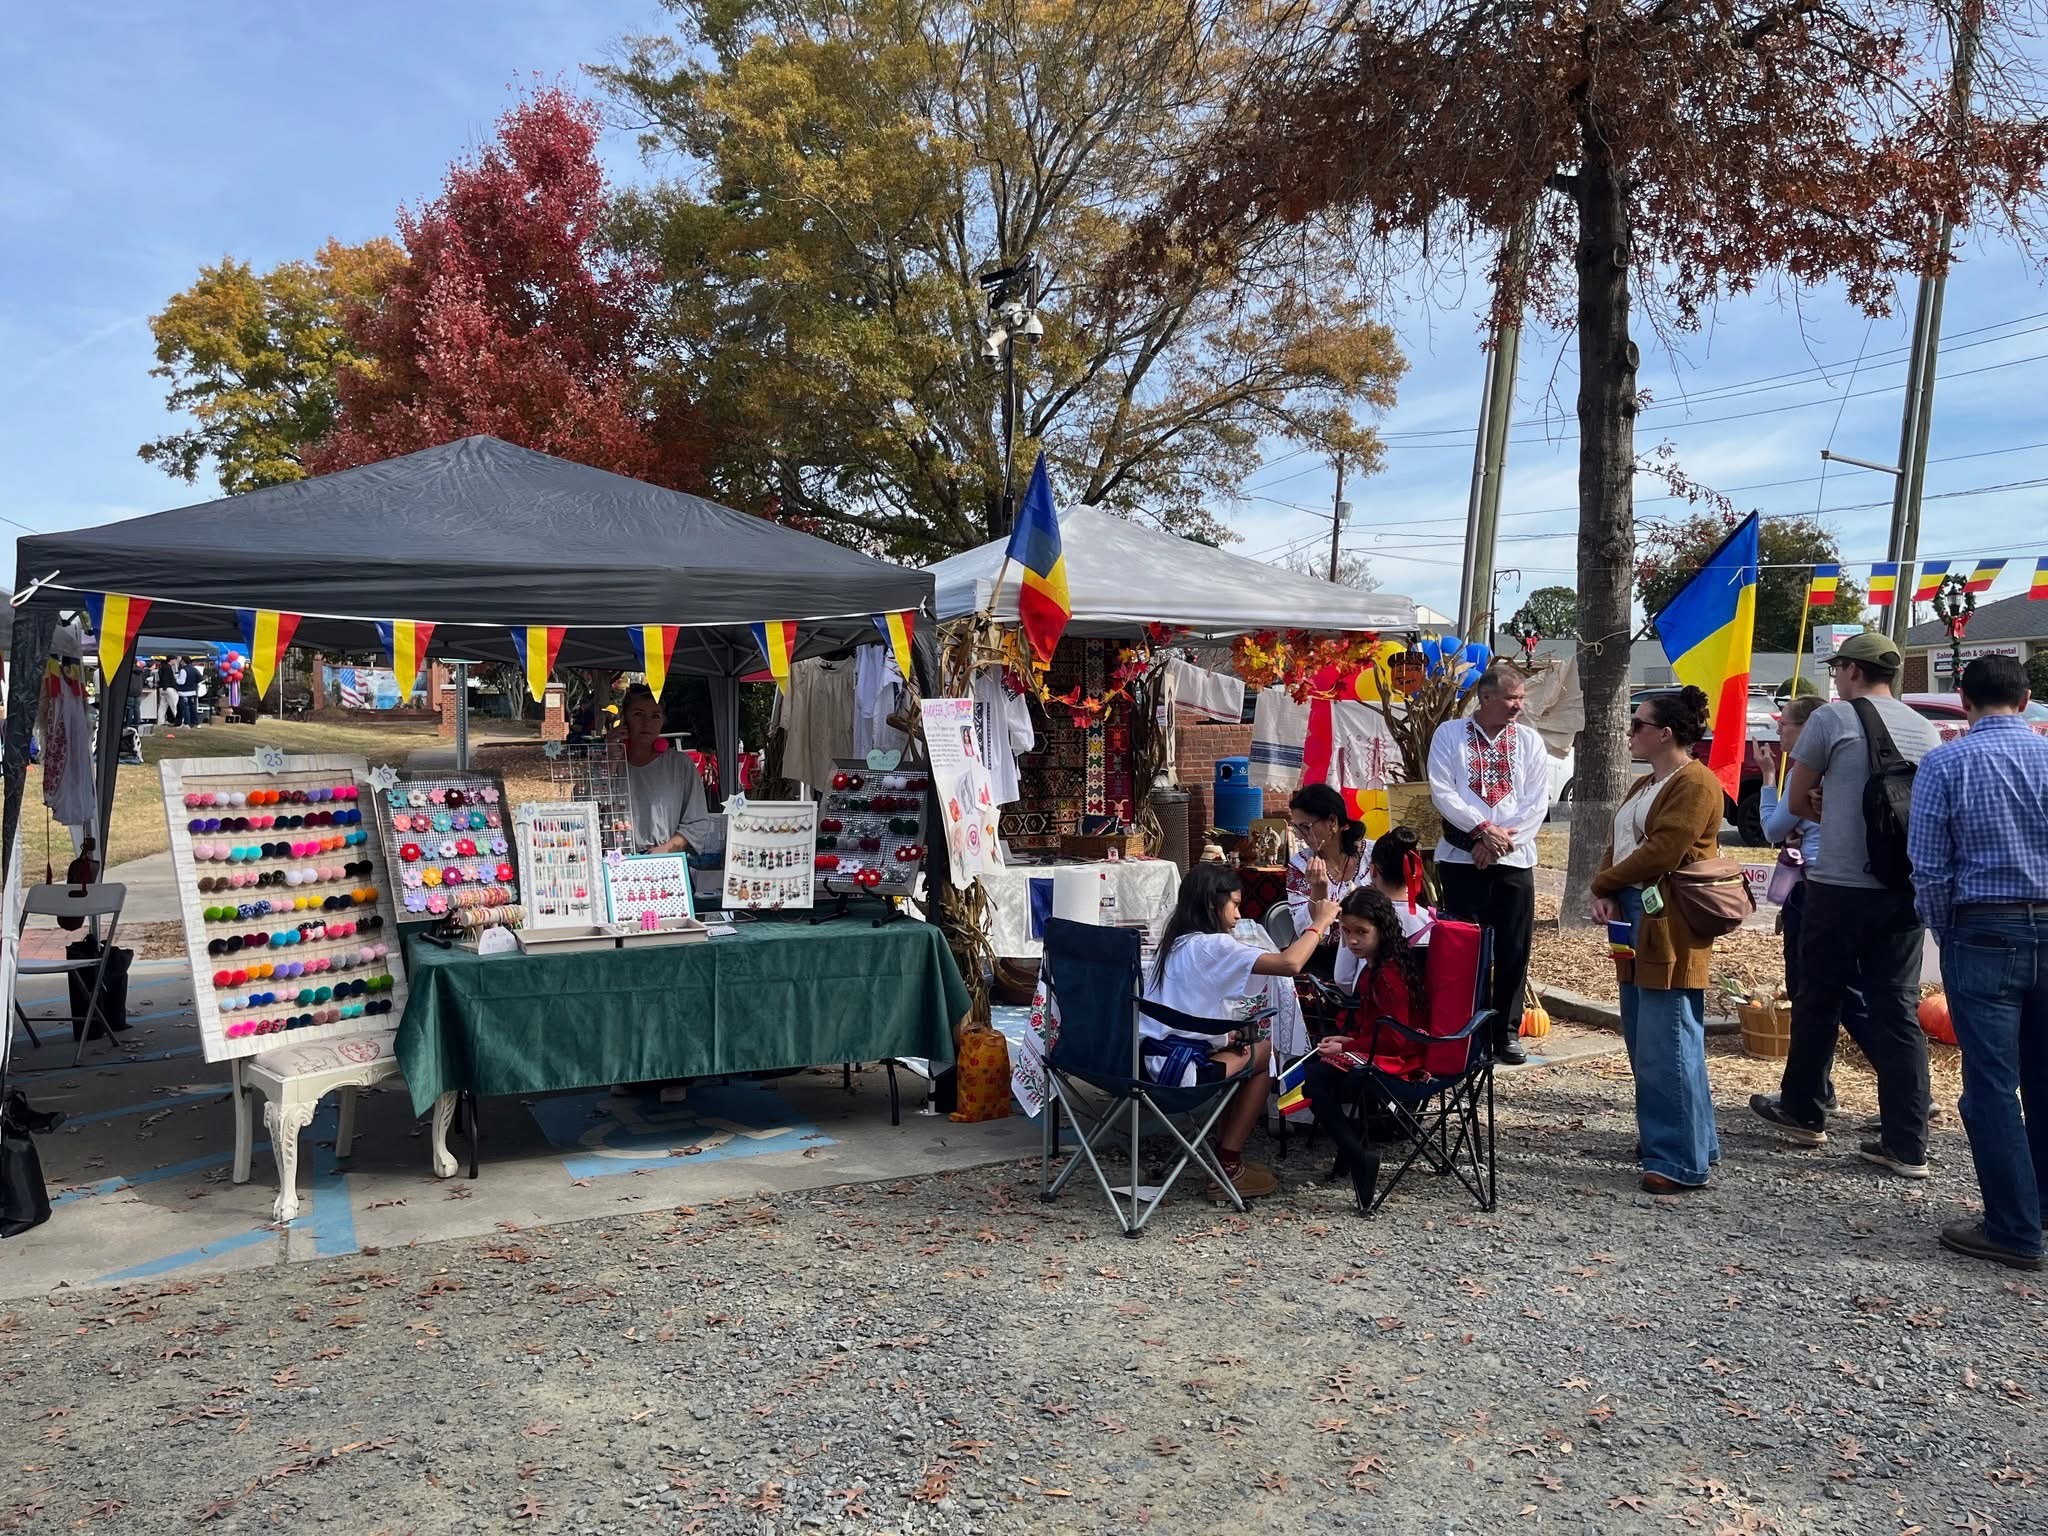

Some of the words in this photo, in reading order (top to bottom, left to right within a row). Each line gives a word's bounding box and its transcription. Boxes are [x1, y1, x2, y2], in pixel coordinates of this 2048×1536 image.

[1973, 649, 1978, 657] &
[1979, 648, 1994, 657] Suite
[1996, 647, 2017, 656] Rental
[263, 753, 283, 767] 25
[377, 768, 393, 783] 15
